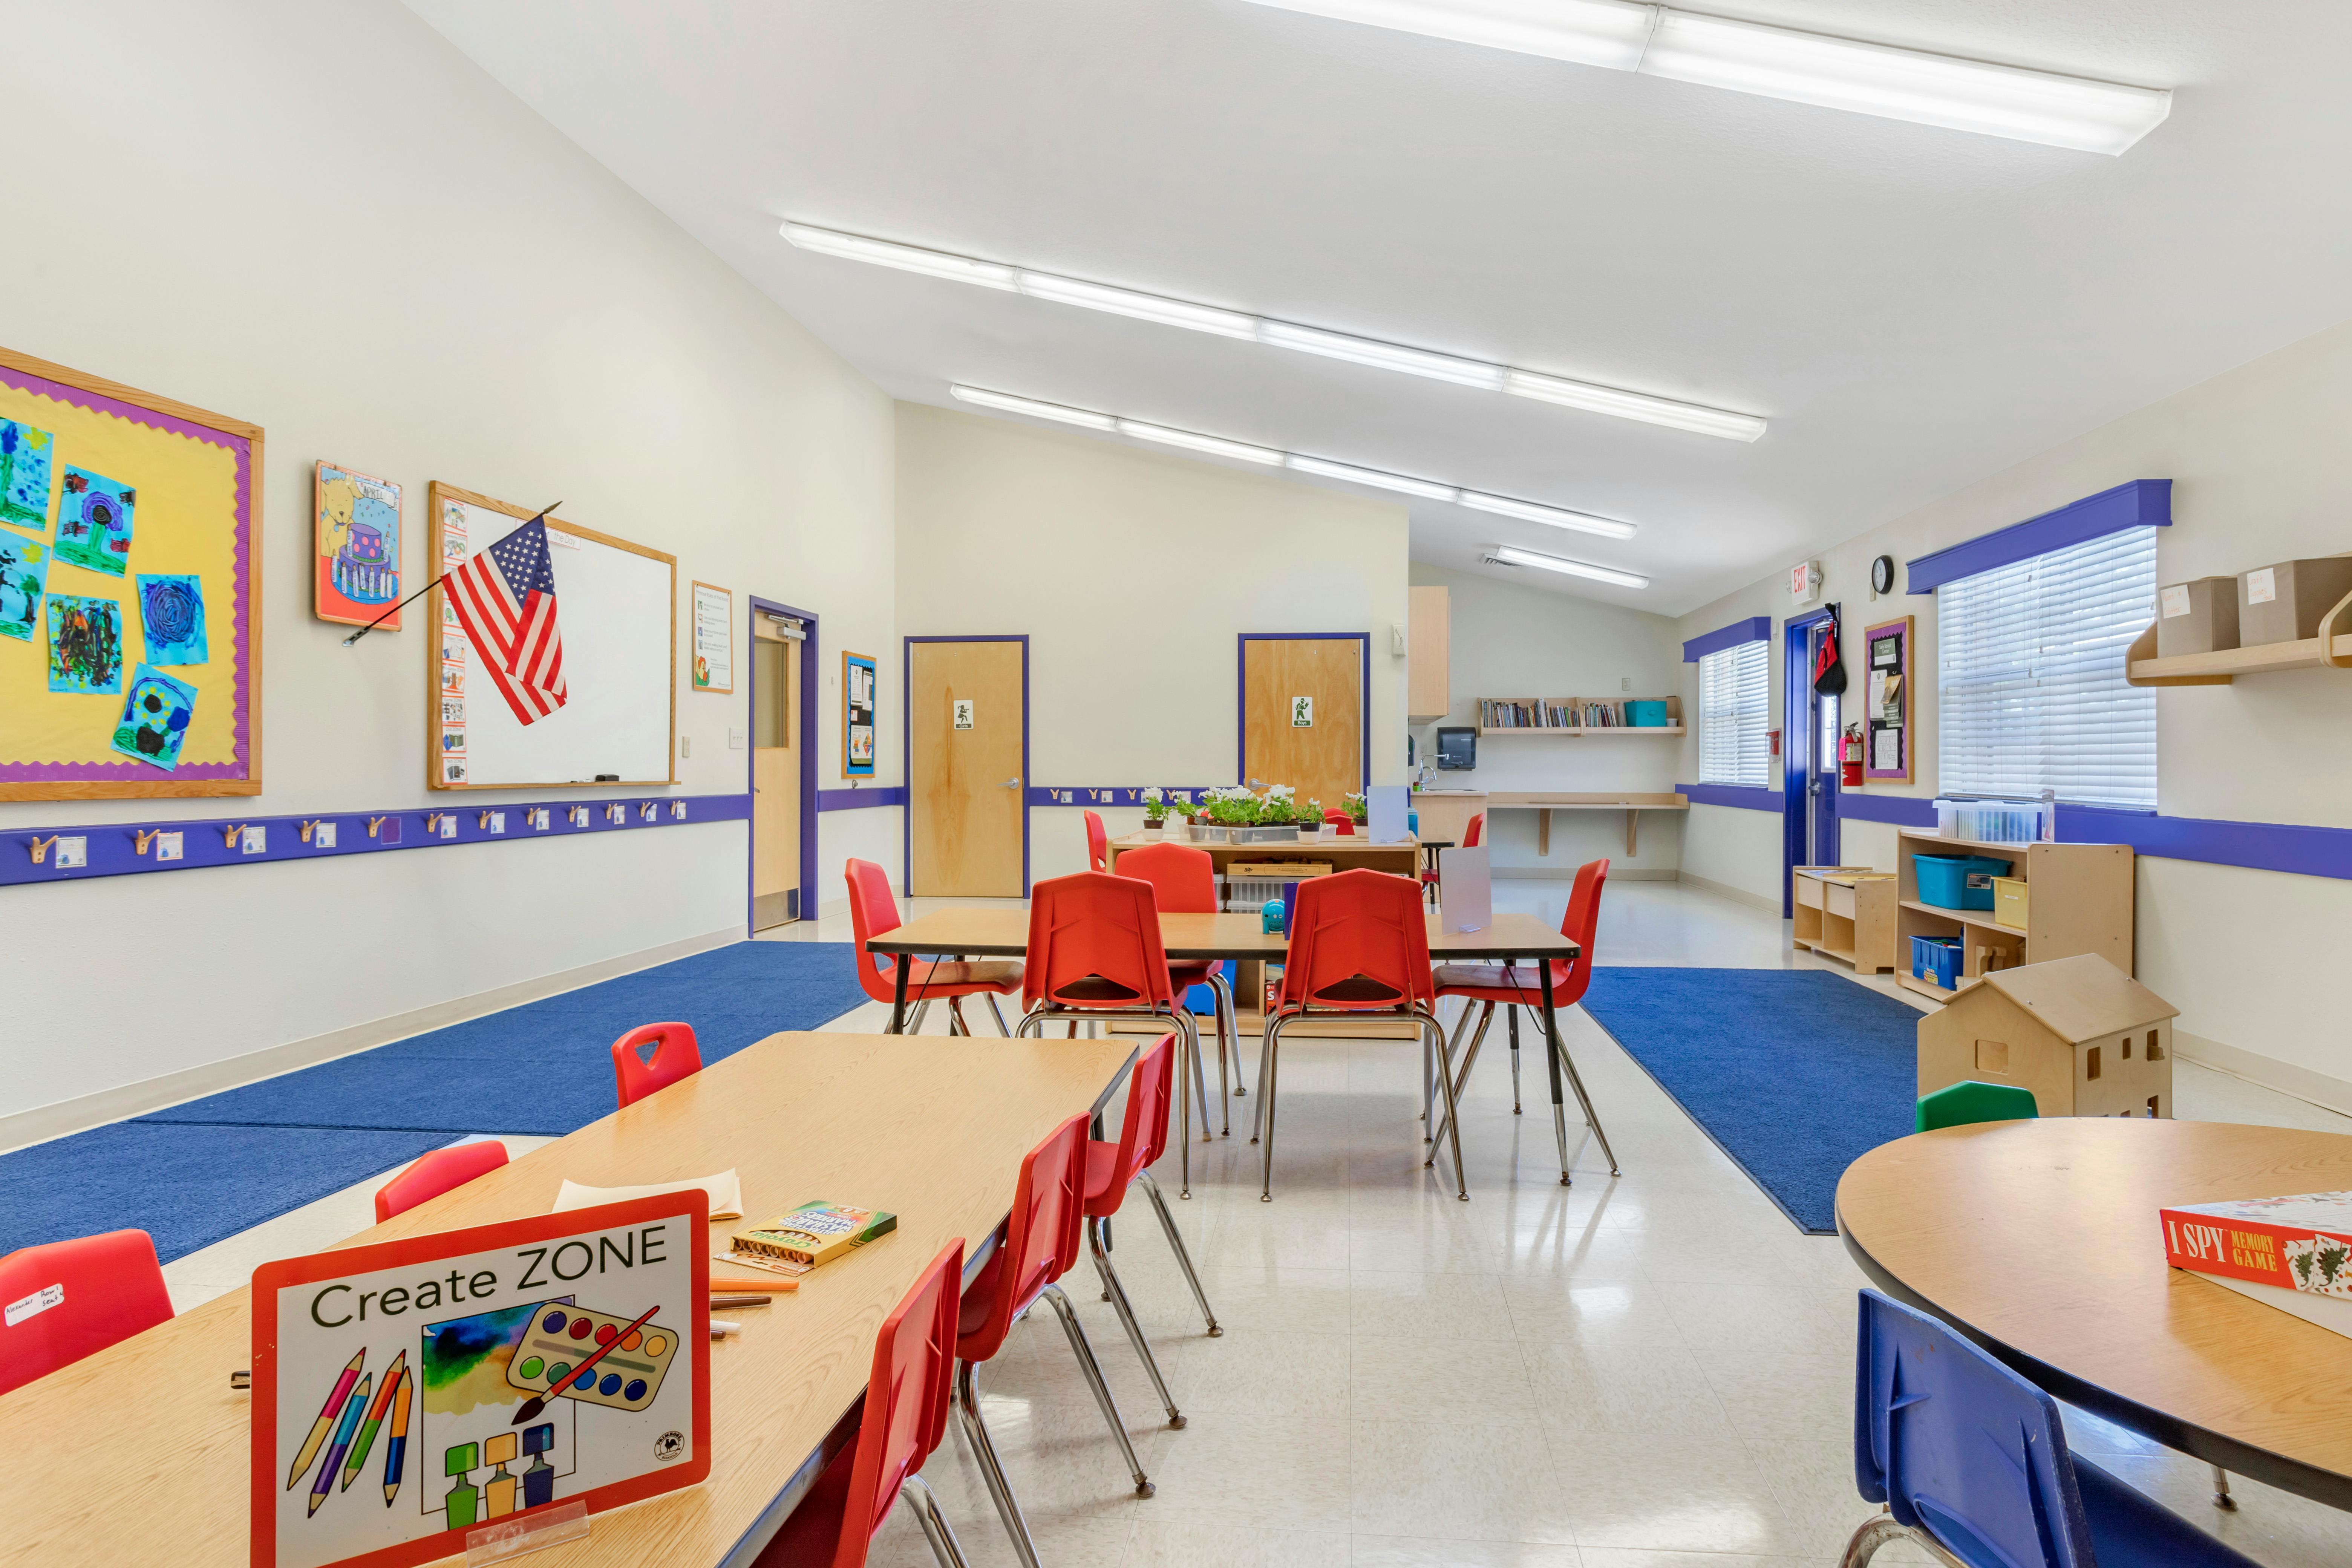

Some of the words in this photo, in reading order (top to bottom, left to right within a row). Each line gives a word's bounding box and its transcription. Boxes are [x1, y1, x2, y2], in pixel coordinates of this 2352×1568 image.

[363, 486, 384, 500] APRIL
[554, 531, 564, 542] the
[565, 536, 576, 547] Day
[1794, 565, 1806, 593] EXIT
[803, 1211, 857, 1226] MARKERS
[779, 1220, 835, 1235] ULTRA-CLEAN
[751, 1232, 812, 1248] Crayola
[2167, 1220, 2181, 1254] I
[2183, 1223, 2226, 1263] SPY
[2230, 1230, 2274, 1253] MEMORY
[2233, 1248, 2277, 1272] GAME
[312, 1270, 498, 1328] Create
[517, 1225, 667, 1291] ZONE
[6, 1299, 33, 1315] Alexander
[657, 1432, 682, 1445] PRIMROSE
